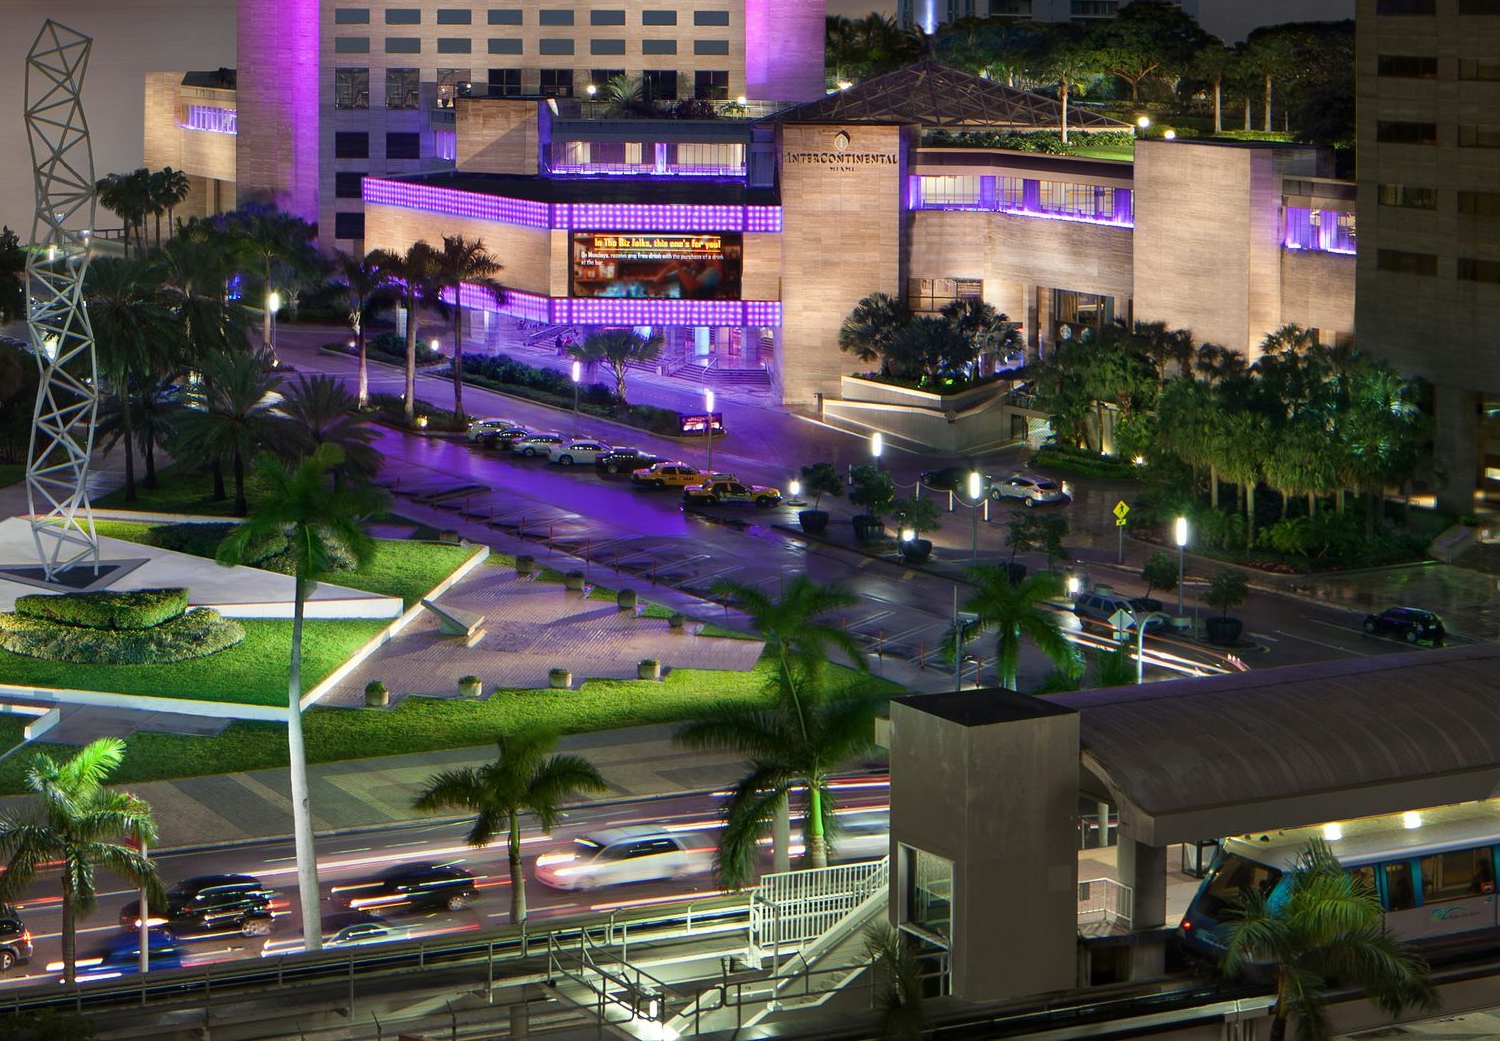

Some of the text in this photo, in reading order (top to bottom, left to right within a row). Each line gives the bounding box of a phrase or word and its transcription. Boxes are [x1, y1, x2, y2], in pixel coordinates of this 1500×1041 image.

[594, 237, 721, 249] In The Biz folks, this one's for you!
